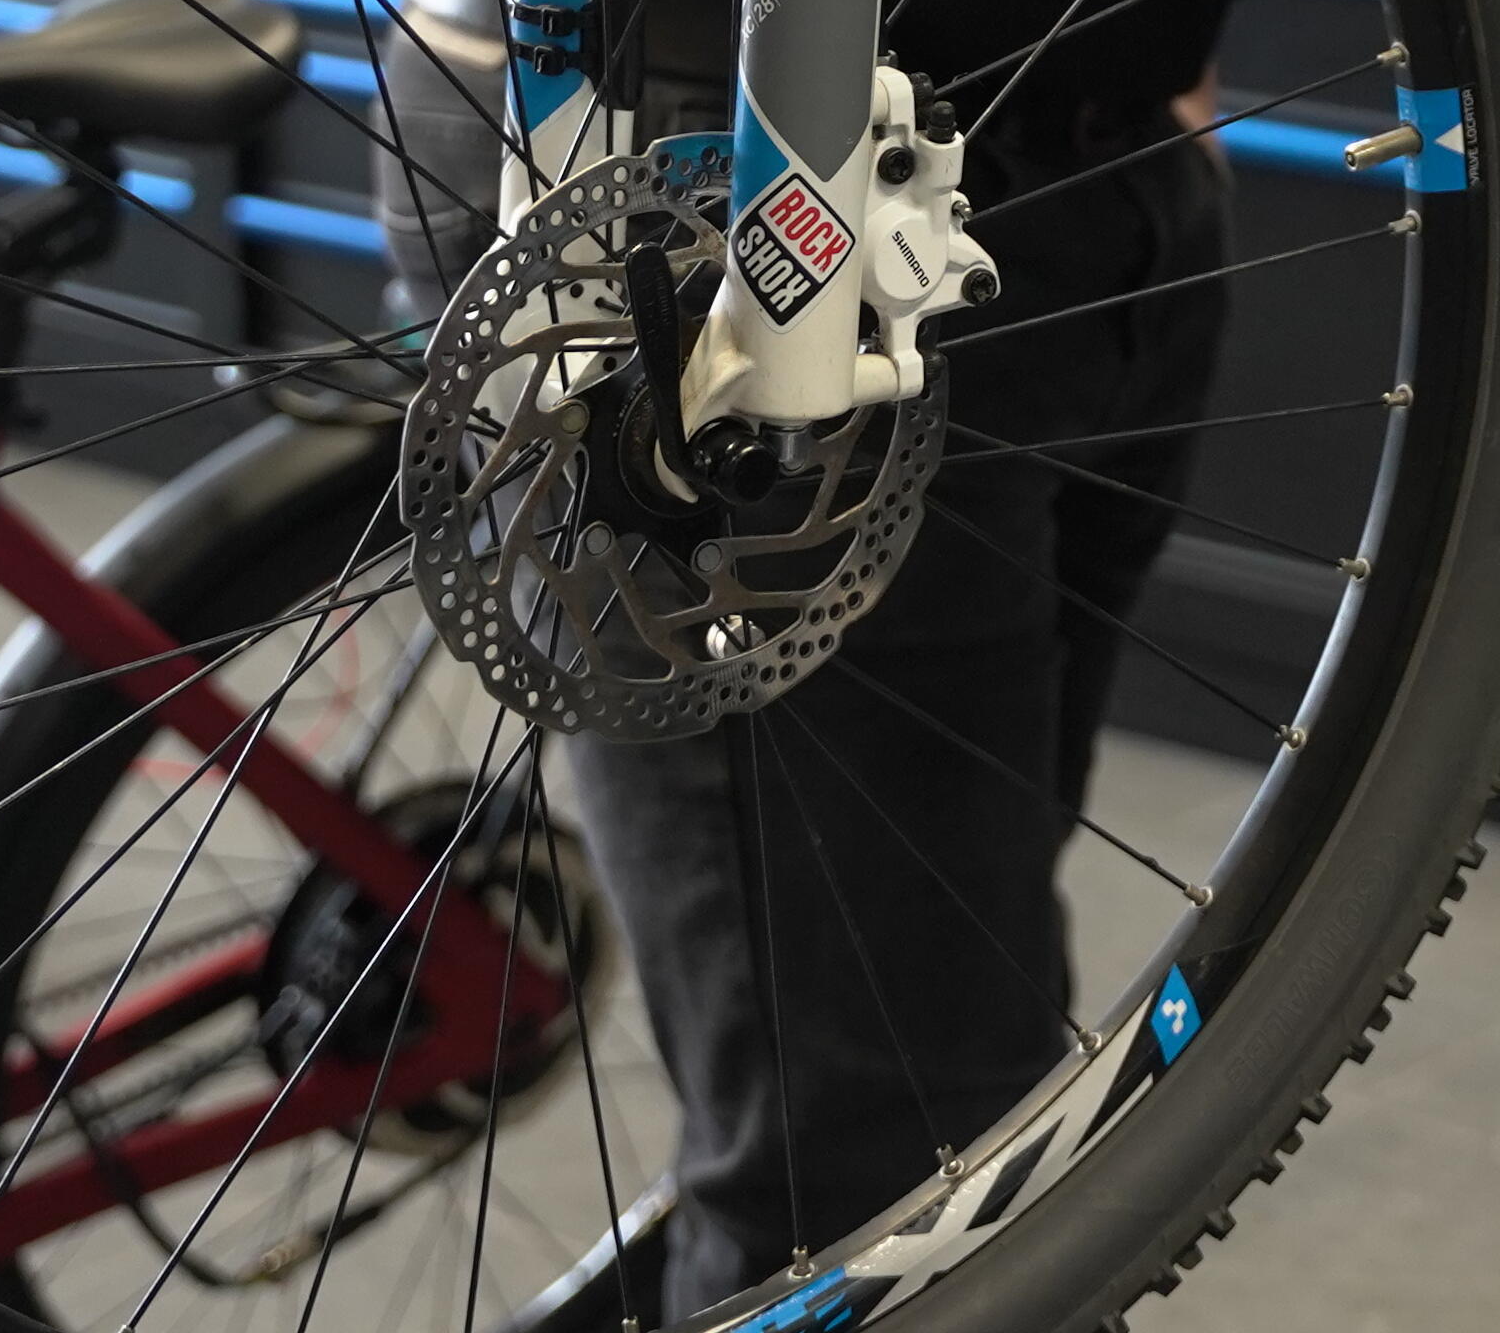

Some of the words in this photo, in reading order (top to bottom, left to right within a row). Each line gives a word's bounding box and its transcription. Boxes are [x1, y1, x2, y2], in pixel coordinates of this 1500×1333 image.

[1462, 89, 1477, 144] LOCATOR
[1468, 147, 1480, 187] VALVE
[767, 188, 848, 273] ROCK
[891, 230, 930, 288] SHIMANO
[737, 224, 812, 313] SHOX
